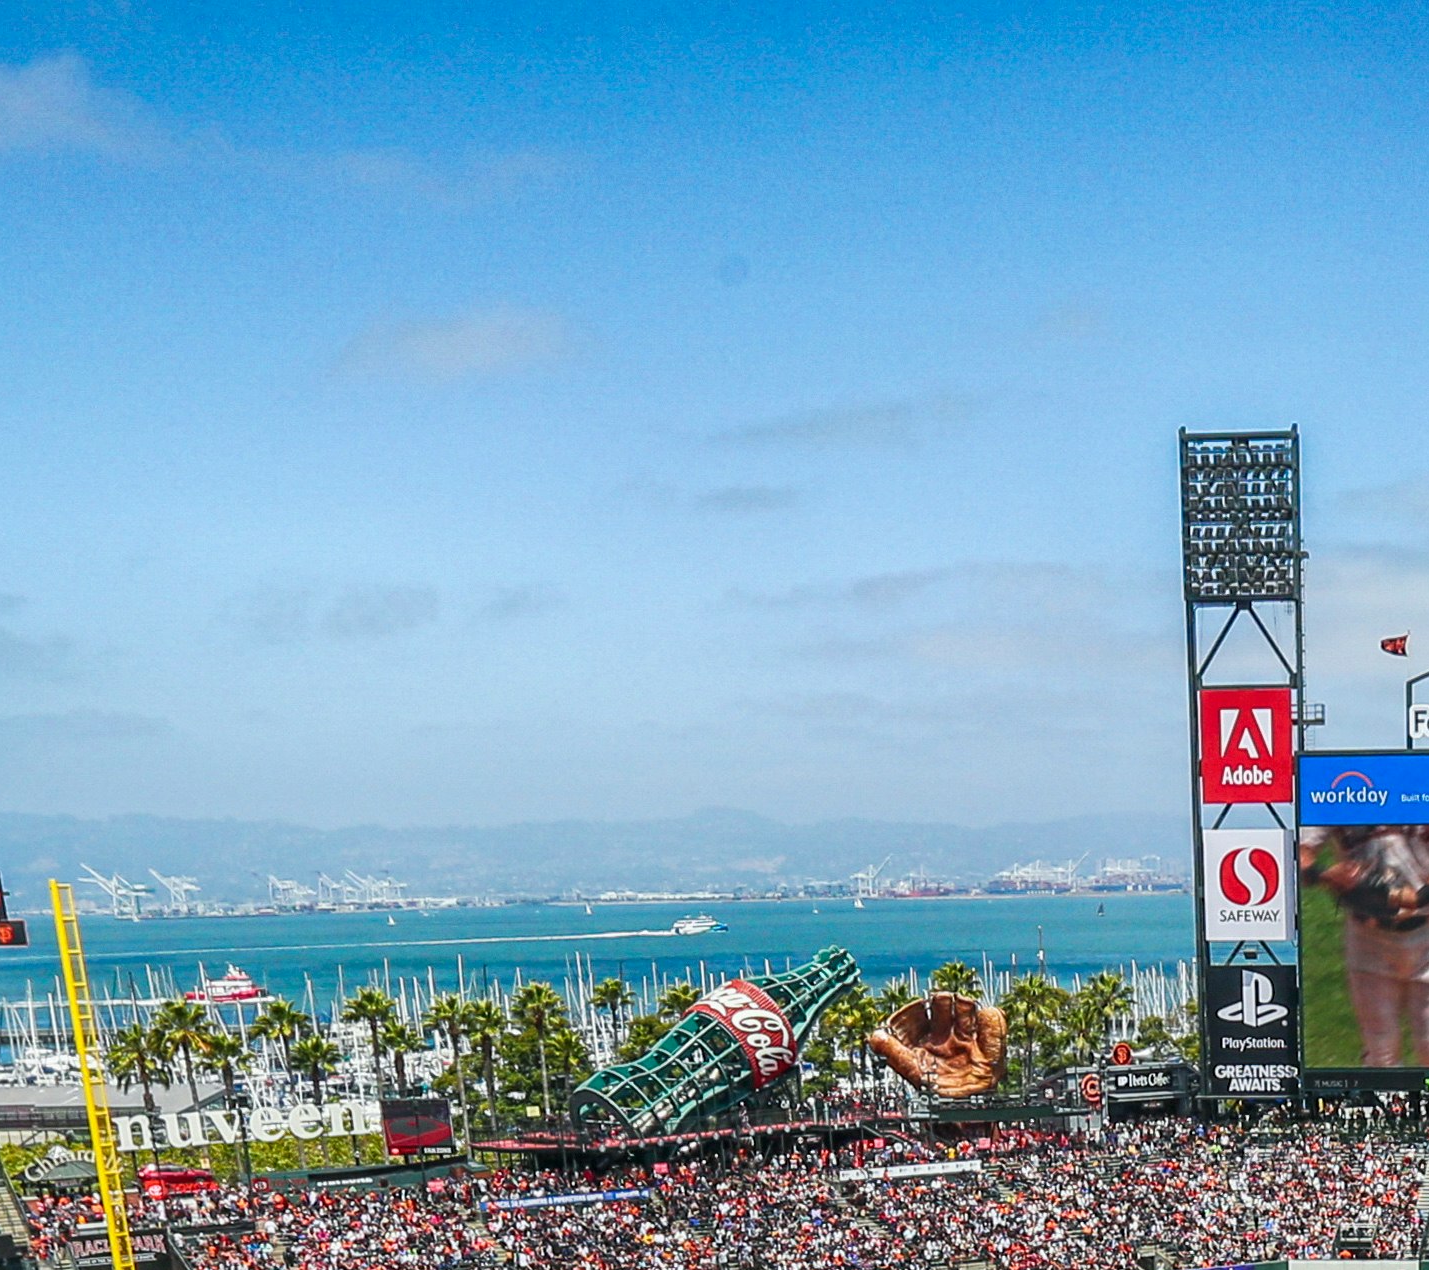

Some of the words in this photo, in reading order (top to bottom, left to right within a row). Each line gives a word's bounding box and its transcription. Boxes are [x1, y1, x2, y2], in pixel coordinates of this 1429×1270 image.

[1222, 765, 1272, 785] Adobe
[1311, 786, 1388, 806] workday
[1401, 793, 1420, 802] Built
[1219, 909, 1280, 923] SAFEWAY
[112, 1100, 370, 1152] nuveen
